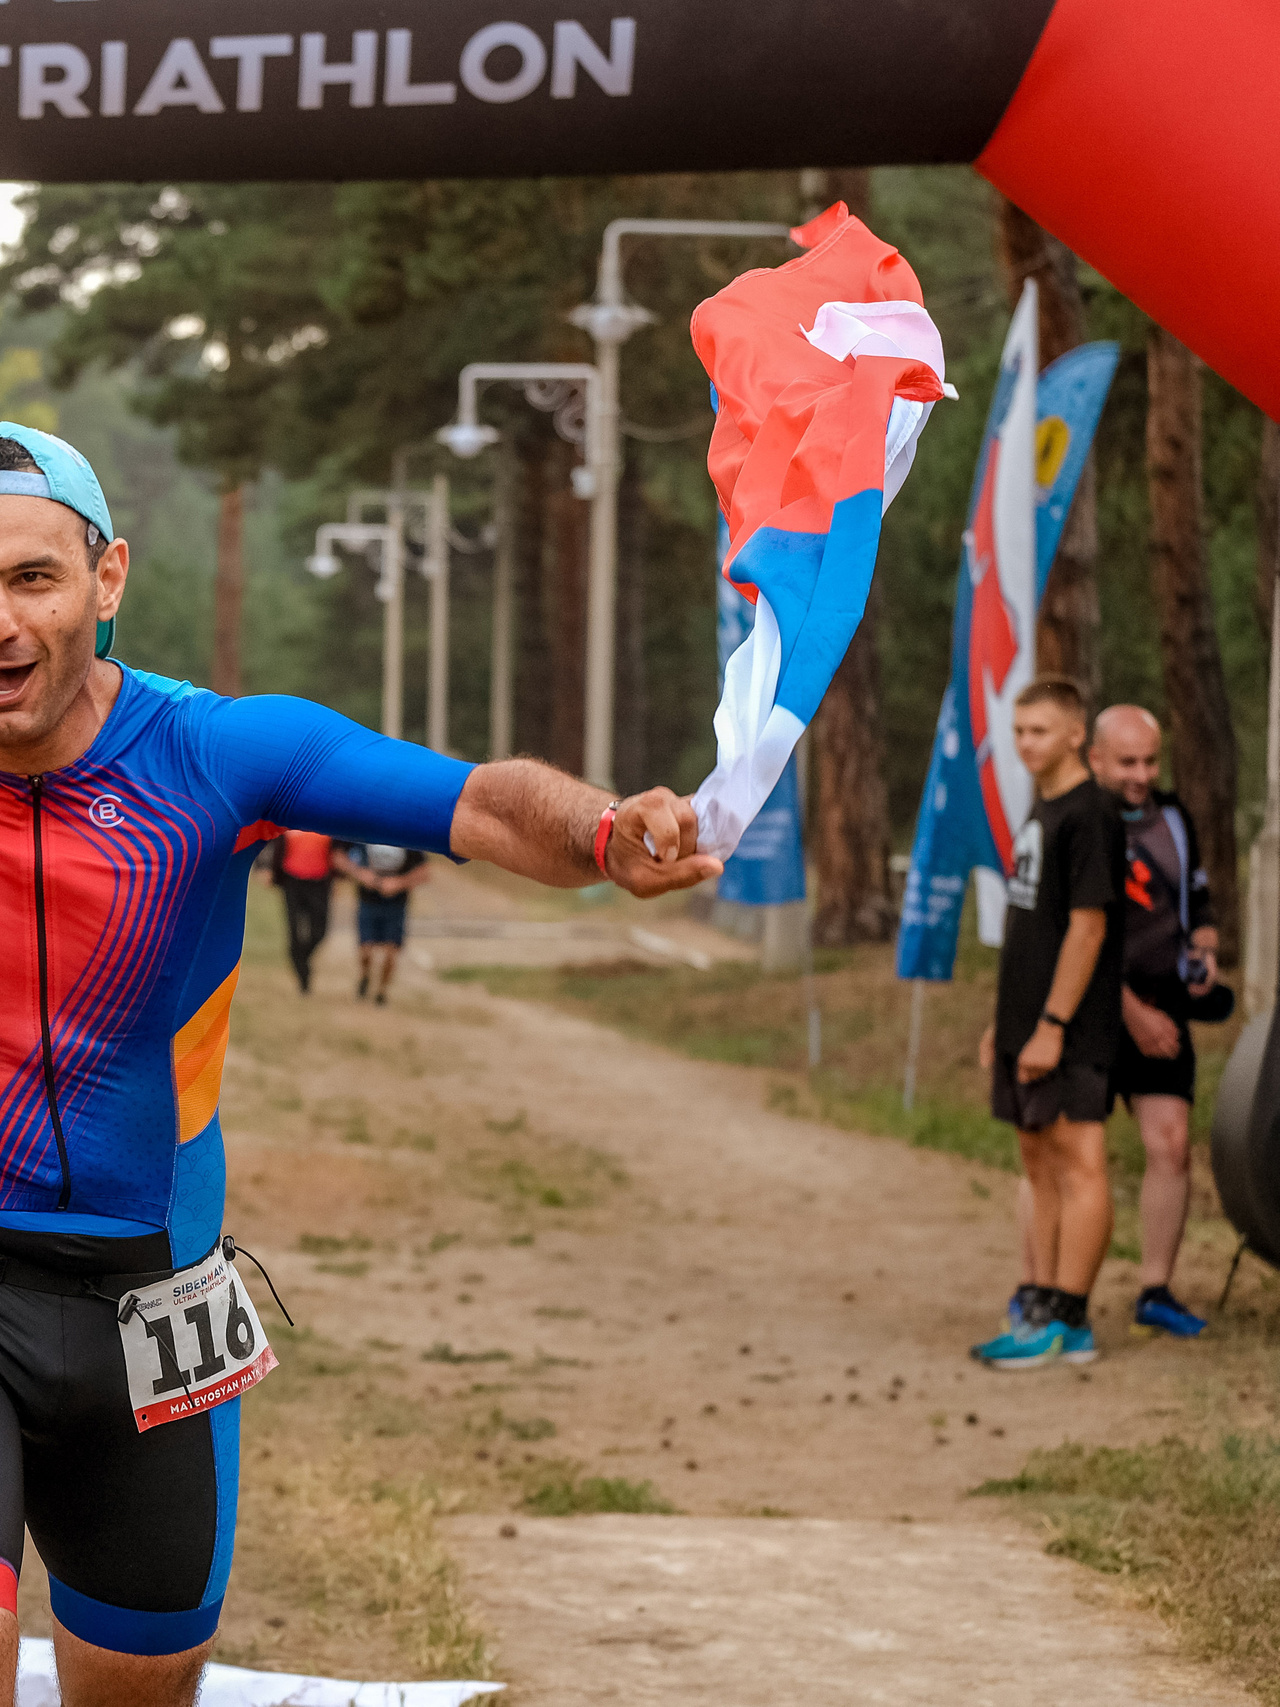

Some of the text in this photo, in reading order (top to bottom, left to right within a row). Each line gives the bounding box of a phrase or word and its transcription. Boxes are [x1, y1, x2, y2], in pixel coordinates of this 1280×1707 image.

[174, 1262, 223, 1297] SIBERMAN
[173, 1292, 197, 1306] ULTRA
[145, 1279, 255, 1395] 116
[170, 1379, 239, 1415] MATEVOSYAN
